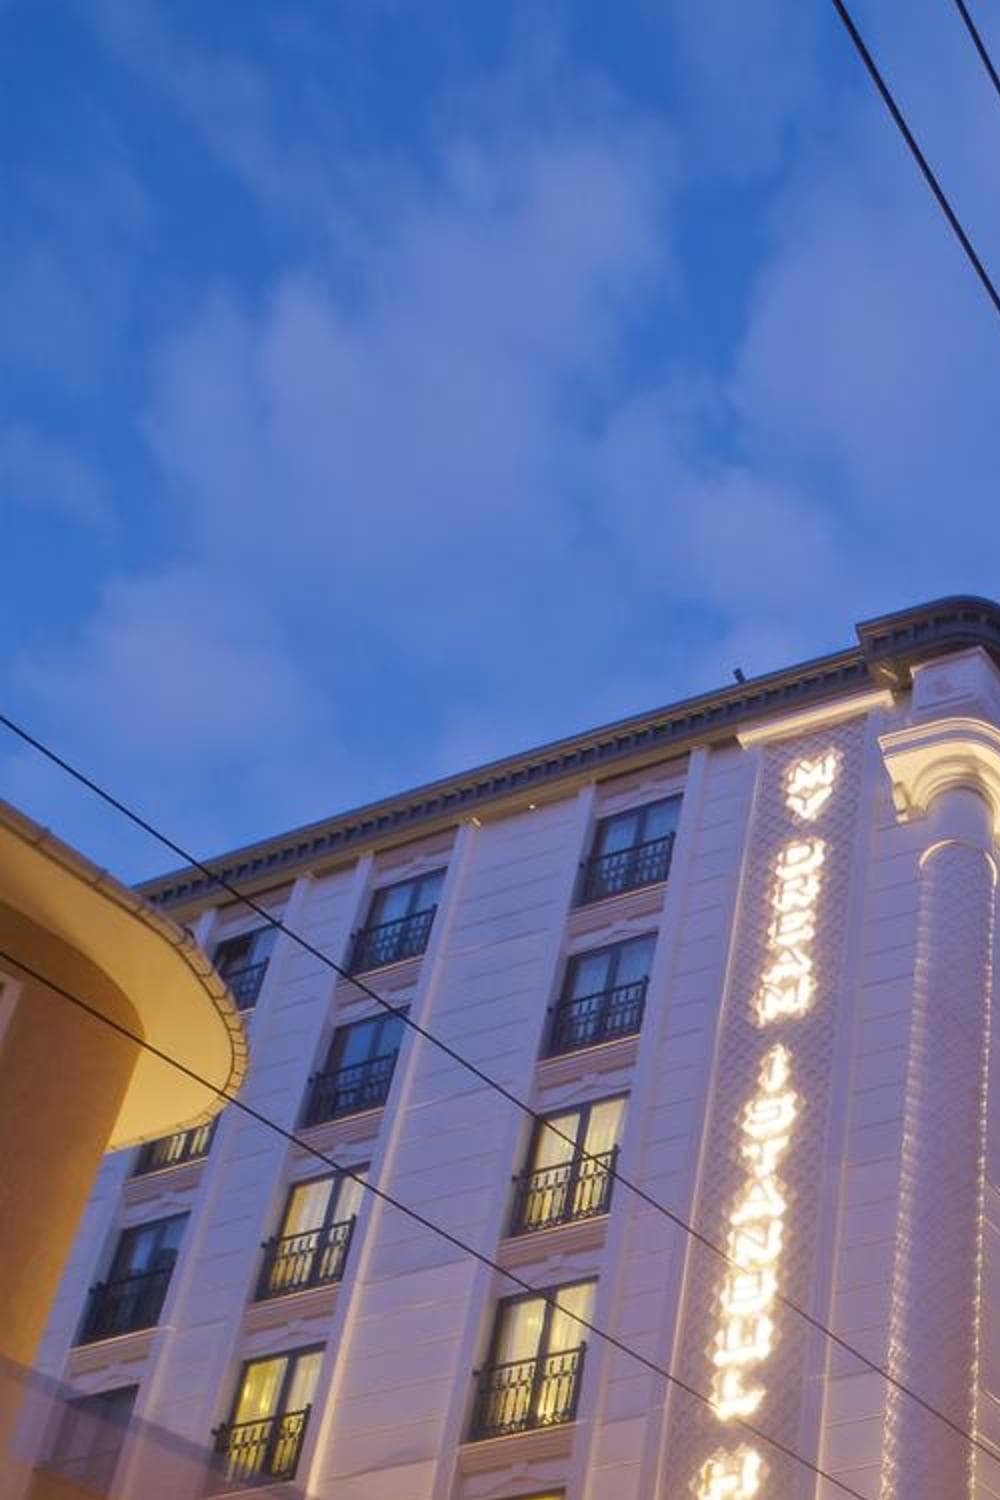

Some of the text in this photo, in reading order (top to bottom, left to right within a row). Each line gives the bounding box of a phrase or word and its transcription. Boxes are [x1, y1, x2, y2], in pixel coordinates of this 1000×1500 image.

[786, 752, 838, 820] MY
[757, 840, 826, 1025] DREAM
[709, 1043, 798, 1420] ISTANBUL
